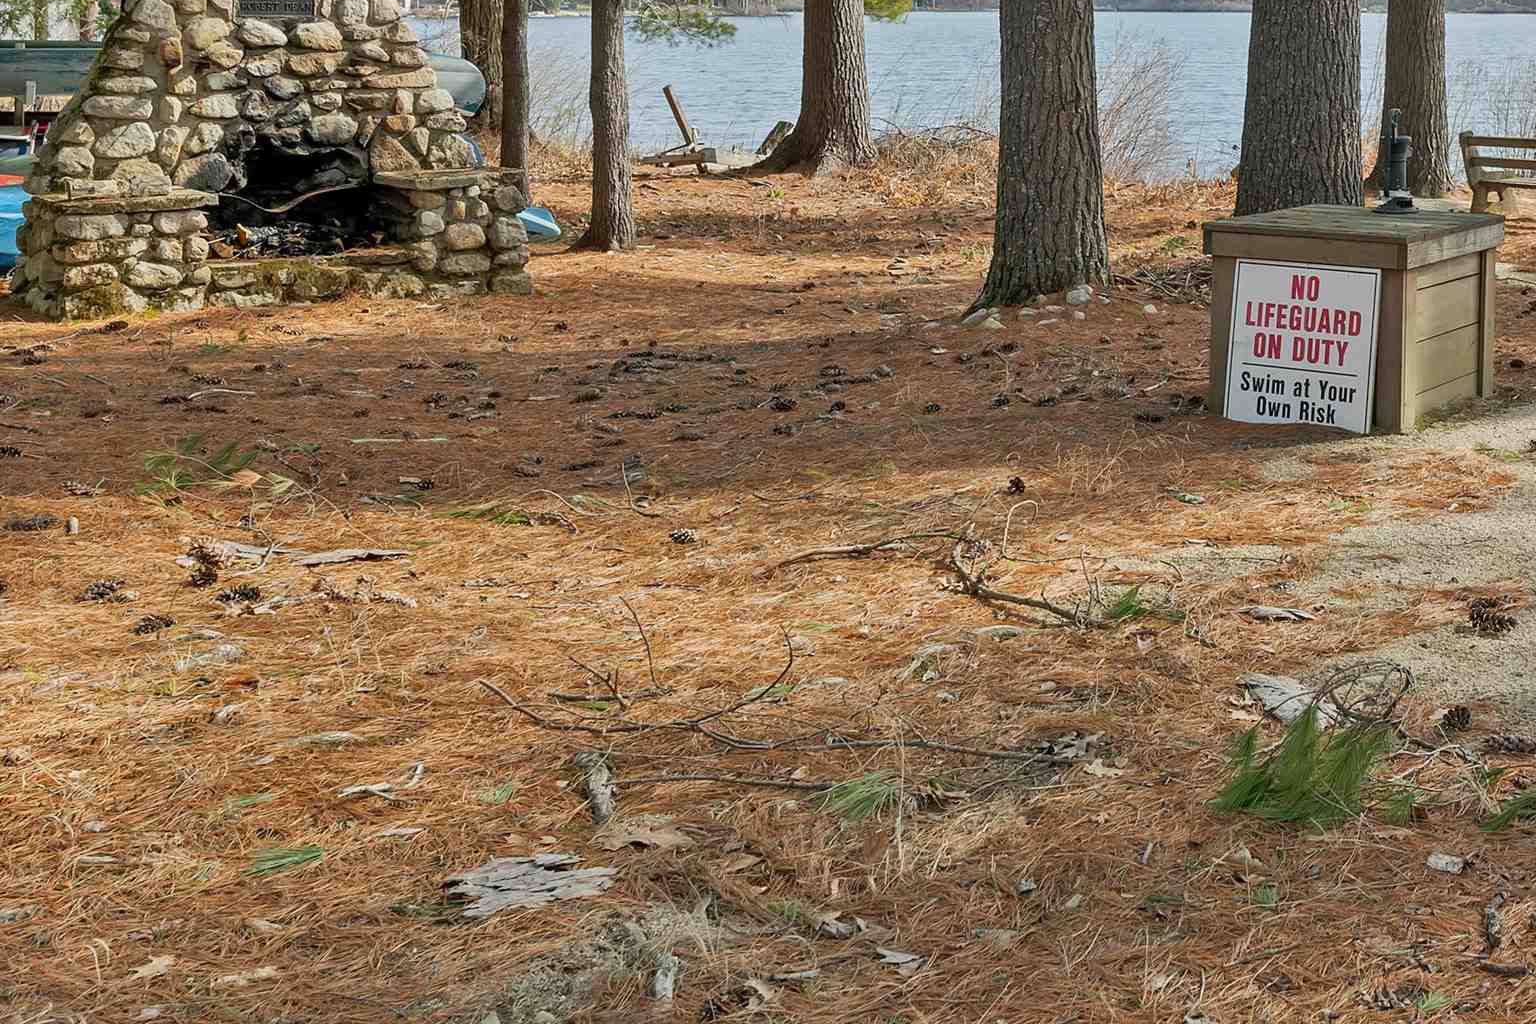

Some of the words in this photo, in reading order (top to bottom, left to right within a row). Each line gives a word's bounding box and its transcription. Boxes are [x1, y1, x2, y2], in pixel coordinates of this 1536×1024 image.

[1291, 274, 1320, 302] NO
[1246, 301, 1362, 337] LIFEGUARD
[1253, 332, 1281, 360] ON
[1292, 337, 1349, 366] DUTY
[1240, 371, 1285, 395] Swim
[1293, 378, 1310, 398] at
[1319, 380, 1356, 403] Your
[1256, 396, 1291, 419] Own
[1299, 401, 1336, 424] Risk
